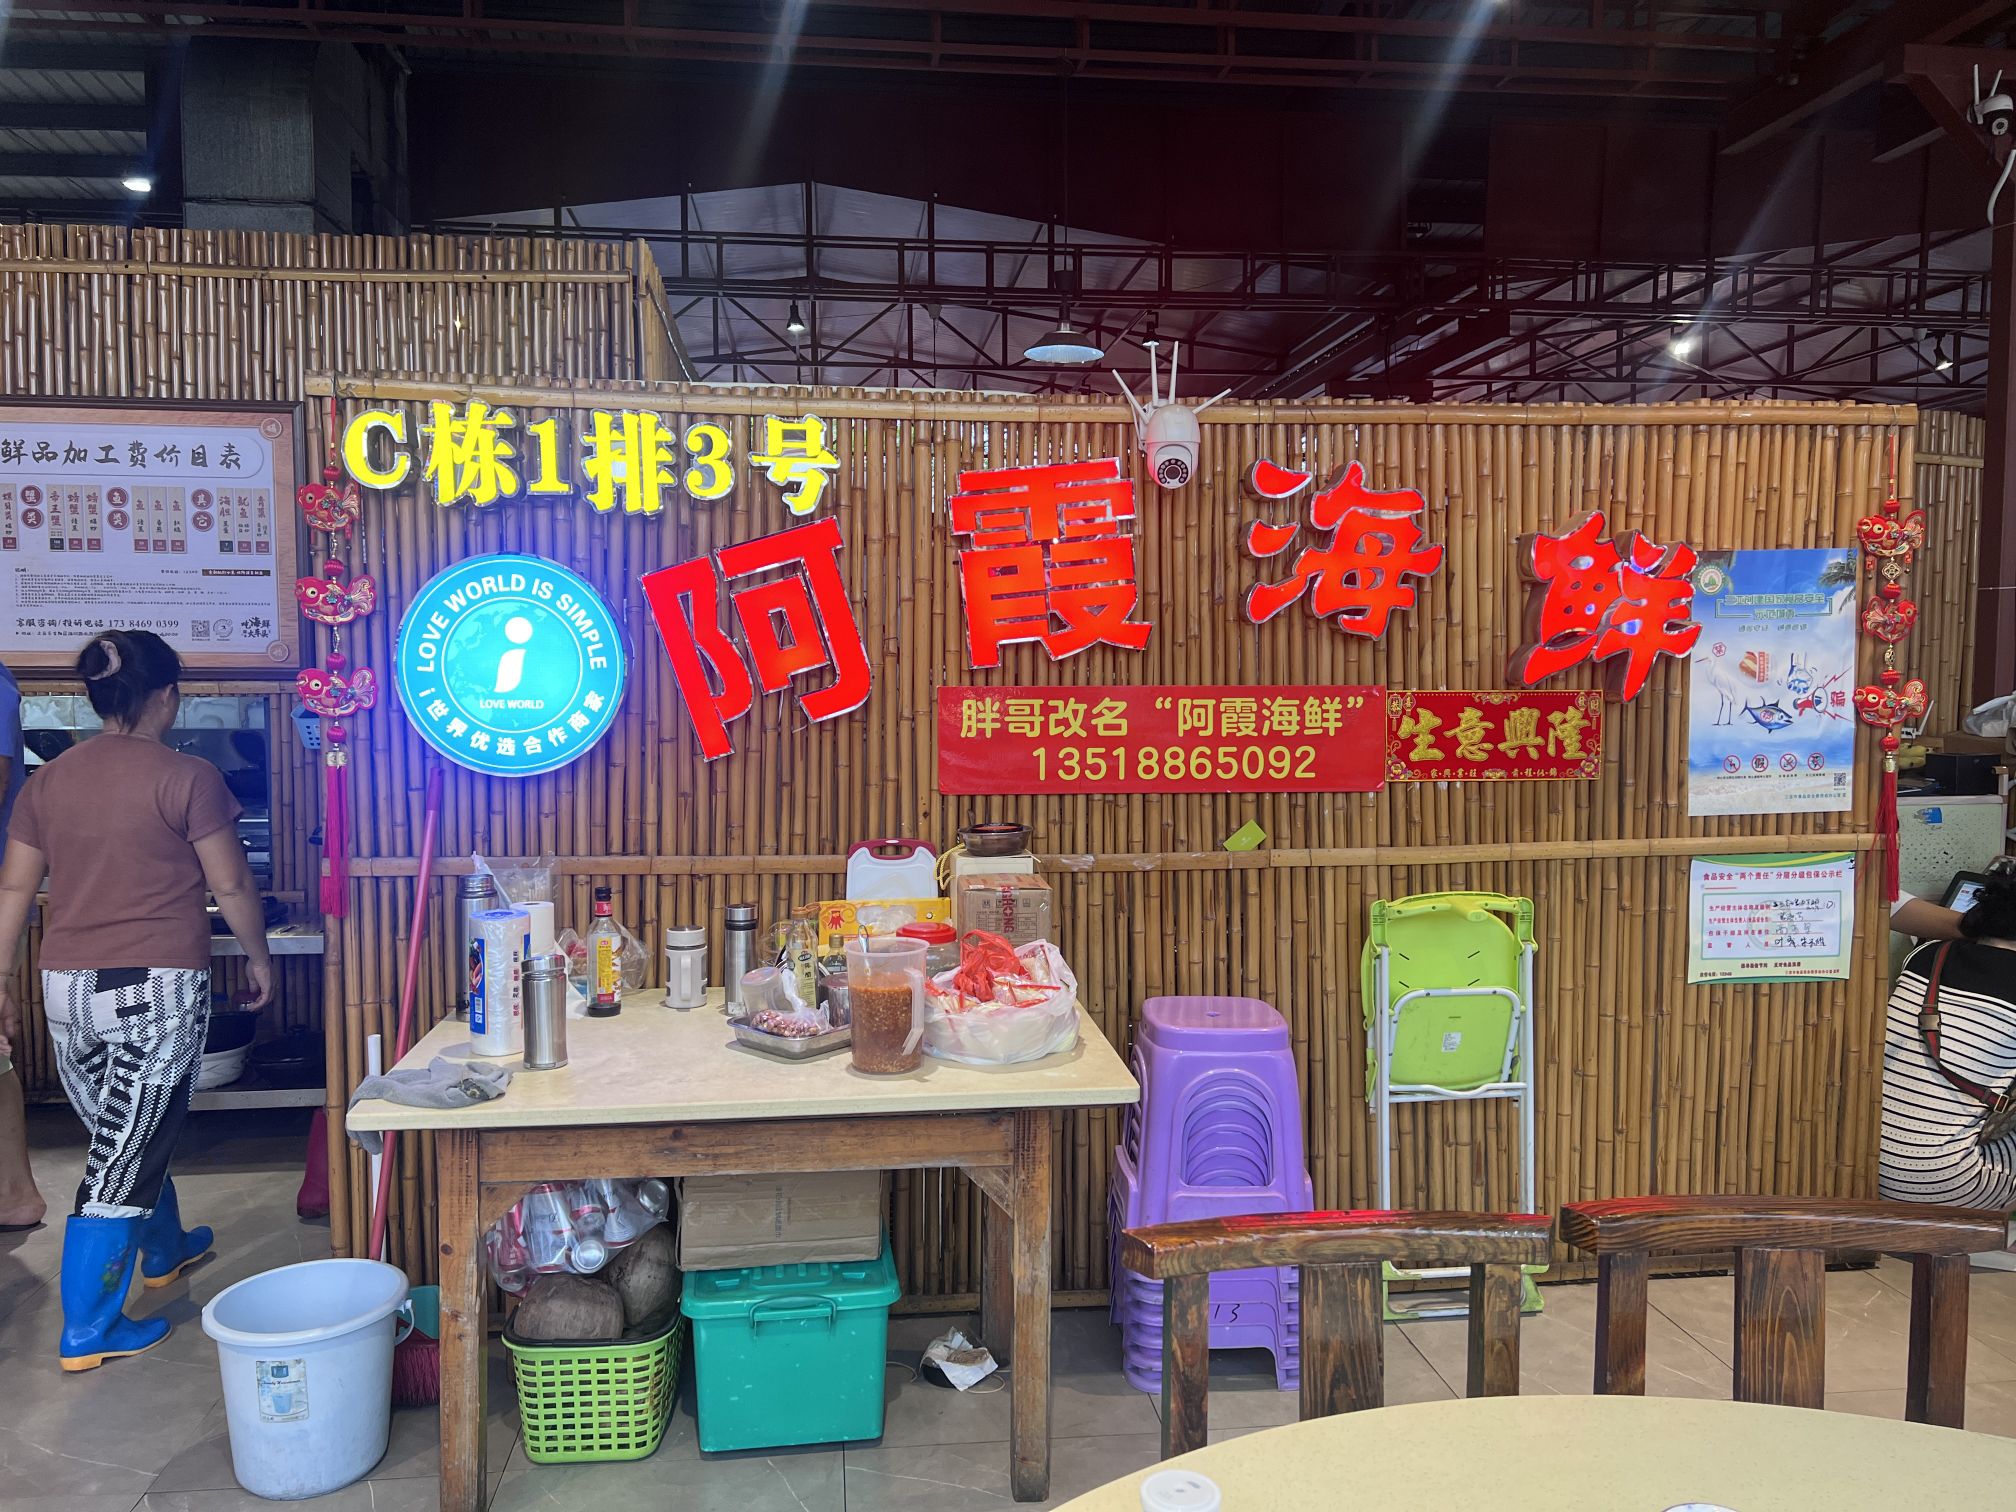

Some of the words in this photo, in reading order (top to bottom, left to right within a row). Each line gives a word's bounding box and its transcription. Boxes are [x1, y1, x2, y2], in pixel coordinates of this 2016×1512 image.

[0, 439, 242, 470] 鲜品加工费价目表
[342, 401, 840, 514] C栋1排3号
[108, 618, 126, 629] 173
[129, 618, 152, 629] 8469
[155, 619, 180, 629] 0399
[417, 610, 450, 673] LOVE
[443, 573, 526, 614] WORLD
[531, 578, 555, 600] IS
[556, 593, 608, 671] SIMPLE
[637, 458, 1704, 763] 阿霞海鲜
[479, 699, 505, 710] LOVE
[507, 699, 545, 710] WORLD
[959, 696, 1130, 739] 胖哥改名
[1154, 695, 1365, 738] “阿霞海鲜”
[1830, 691, 1846, 708] 骗
[1397, 706, 1592, 762] 生意興隆
[1031, 745, 1317, 781] 13518865092
[1214, 1303, 1241, 1323] 13
